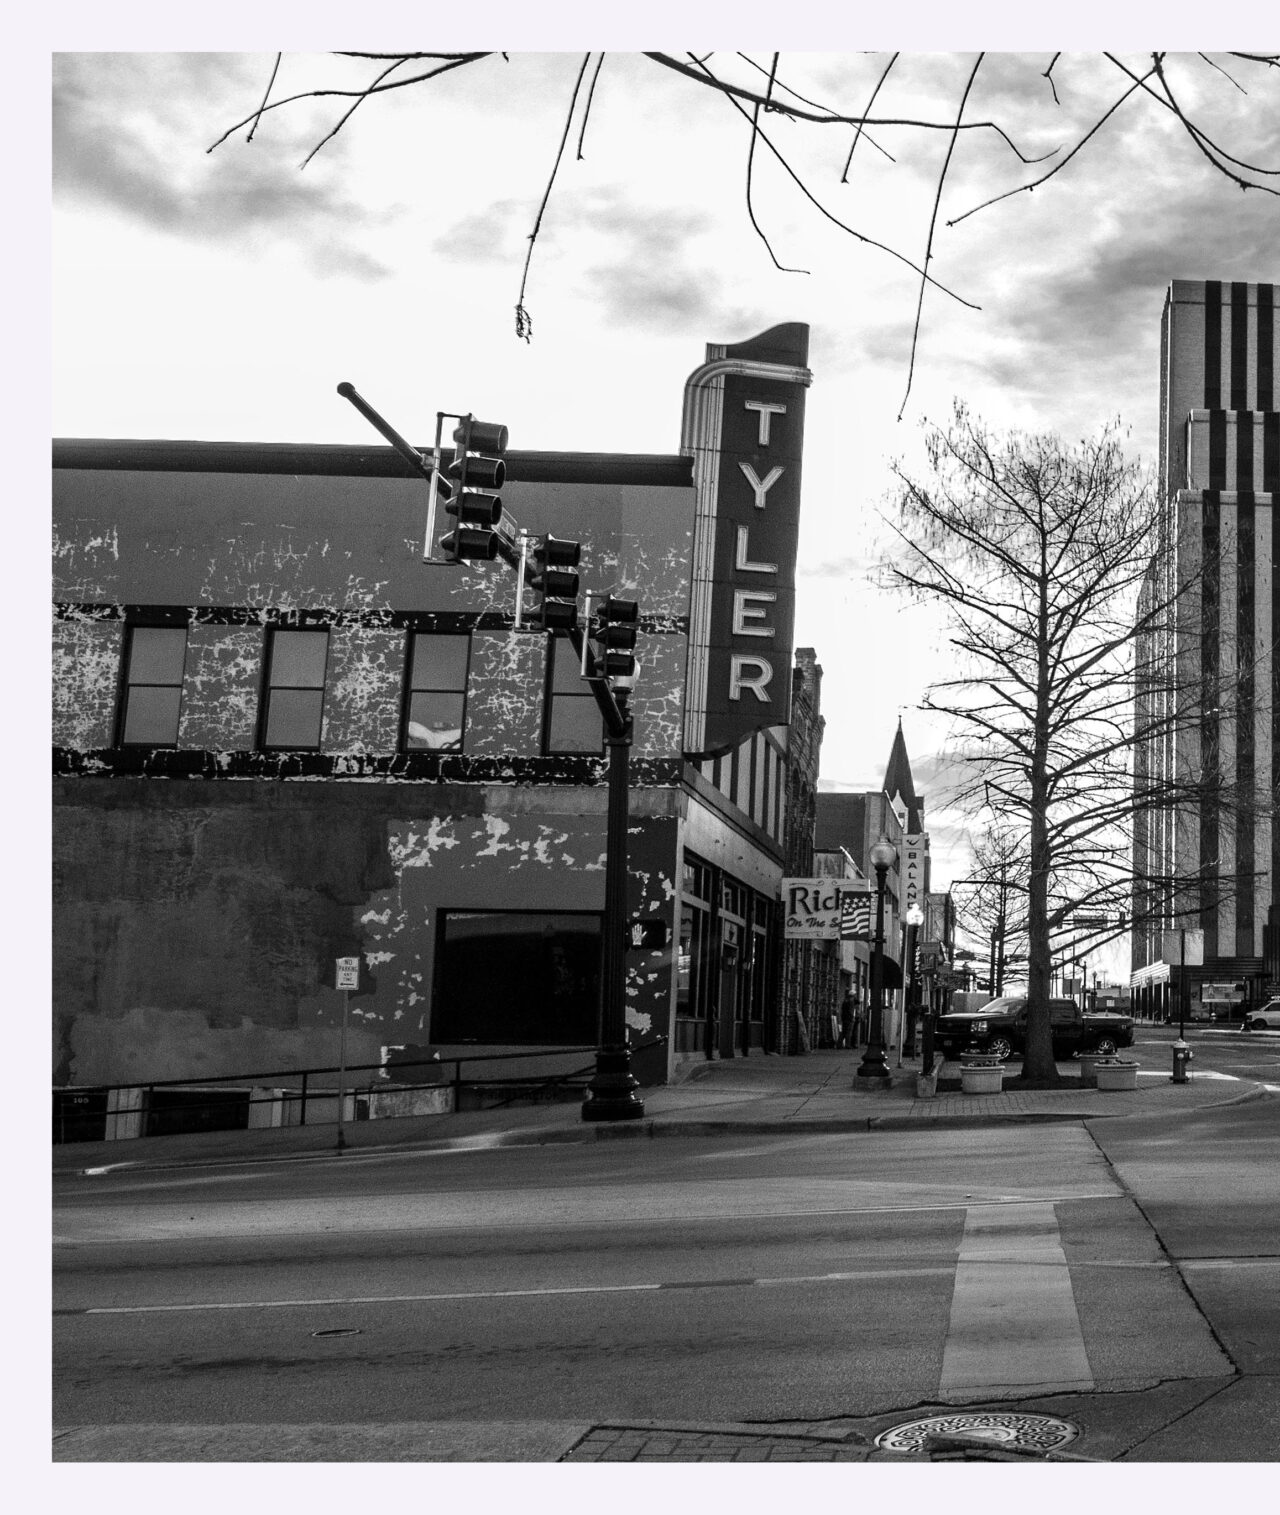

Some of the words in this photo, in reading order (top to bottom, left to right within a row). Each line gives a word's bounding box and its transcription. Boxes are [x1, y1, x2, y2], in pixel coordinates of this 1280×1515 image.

[729, 400, 787, 702] TYLER
[787, 917, 803, 928] On
[806, 917, 826, 928] The
